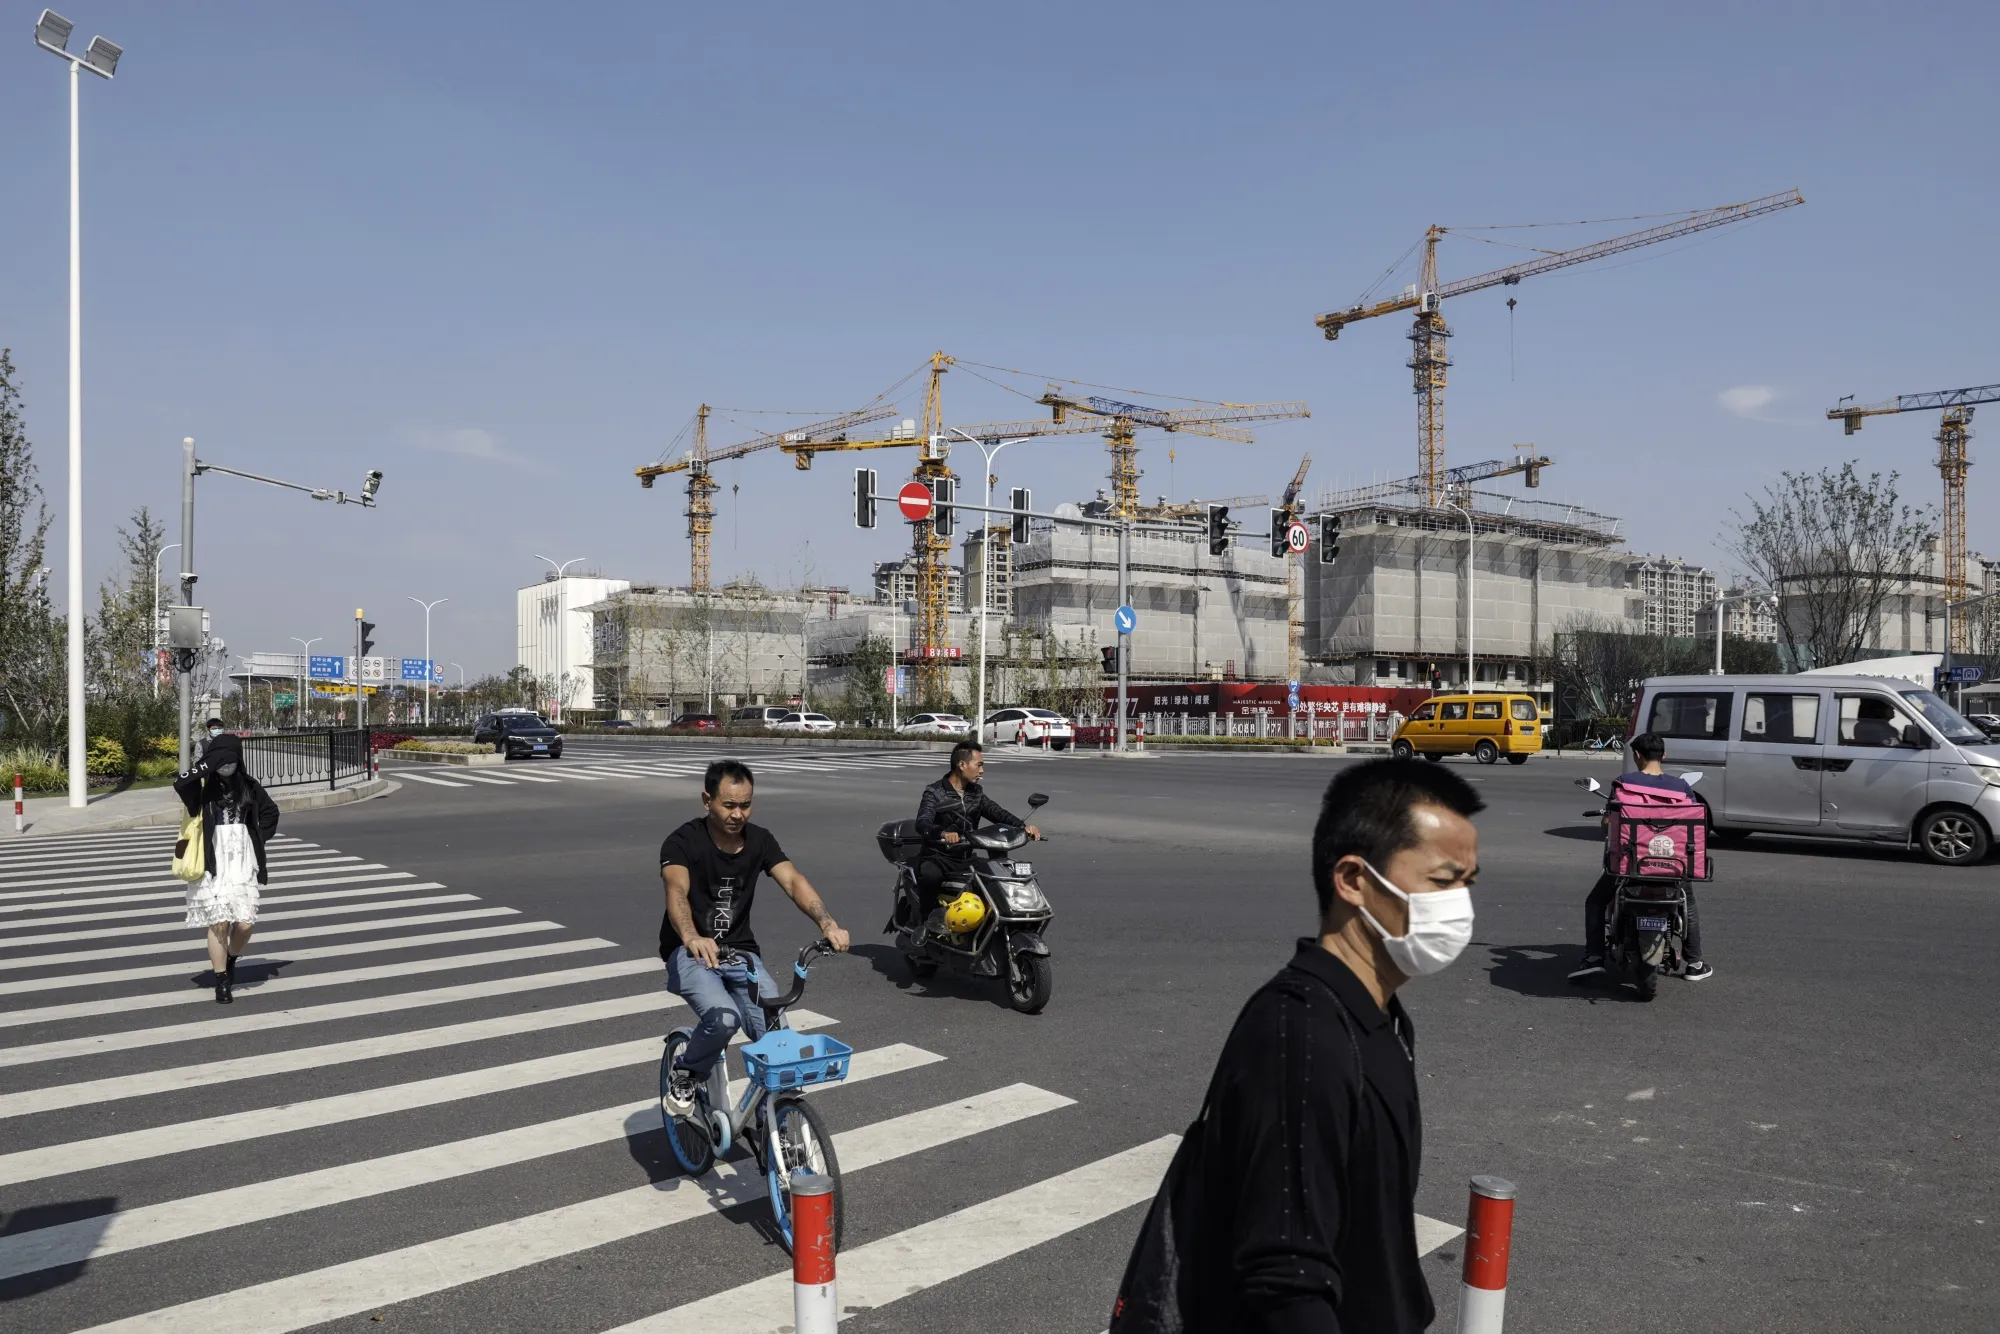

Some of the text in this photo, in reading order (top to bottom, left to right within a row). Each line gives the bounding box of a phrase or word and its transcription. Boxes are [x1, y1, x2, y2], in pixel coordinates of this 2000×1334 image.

[1292, 529, 1304, 547] 60
[1154, 696, 1168, 706] 阳光
[1174, 695, 1189, 705] 绿地
[1232, 723, 1255, 734] 6088
